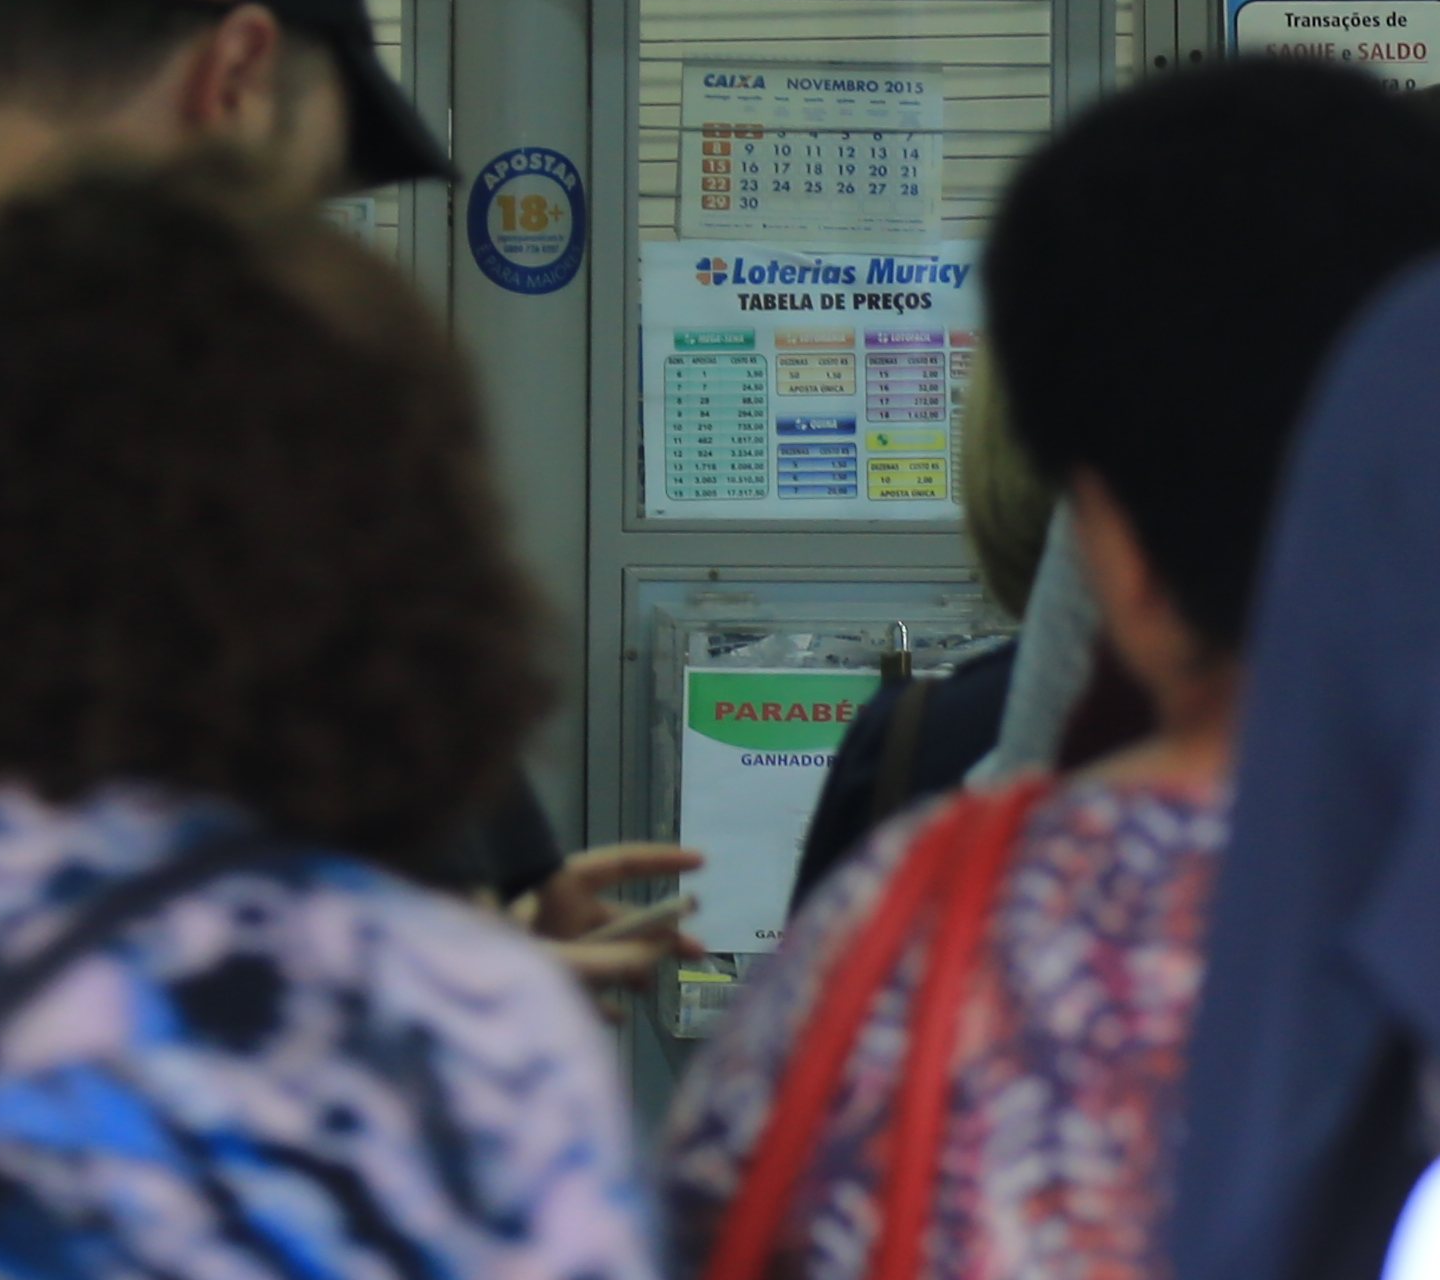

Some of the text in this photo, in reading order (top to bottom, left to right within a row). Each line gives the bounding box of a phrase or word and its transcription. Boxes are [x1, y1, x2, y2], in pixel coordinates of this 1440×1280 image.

[1285, 12, 1408, 31] Transações de
[1266, 42, 1427, 61] SAQUE e SALDO
[703, 73, 925, 94] CAIXA NOVEMBRO 2015
[744, 144, 754, 155] 9
[774, 144, 791, 156] 10
[806, 145, 821, 157] 11
[838, 146, 855, 158] 12
[870, 147, 887, 160] 13
[902, 148, 920, 160] 14
[484, 153, 577, 191] APOSTAR
[708, 161, 918, 178] 15 16 17 18 19 20 21
[706, 179, 919, 196] 22 23 24 25 26 27 28
[706, 196, 759, 209] 29 30
[496, 194, 564, 232] 18+
[732, 255, 971, 289] Loterias Muricy
[737, 292, 933, 315] TABELA DE PREÇOS
[715, 698, 862, 723] PARABÉ
